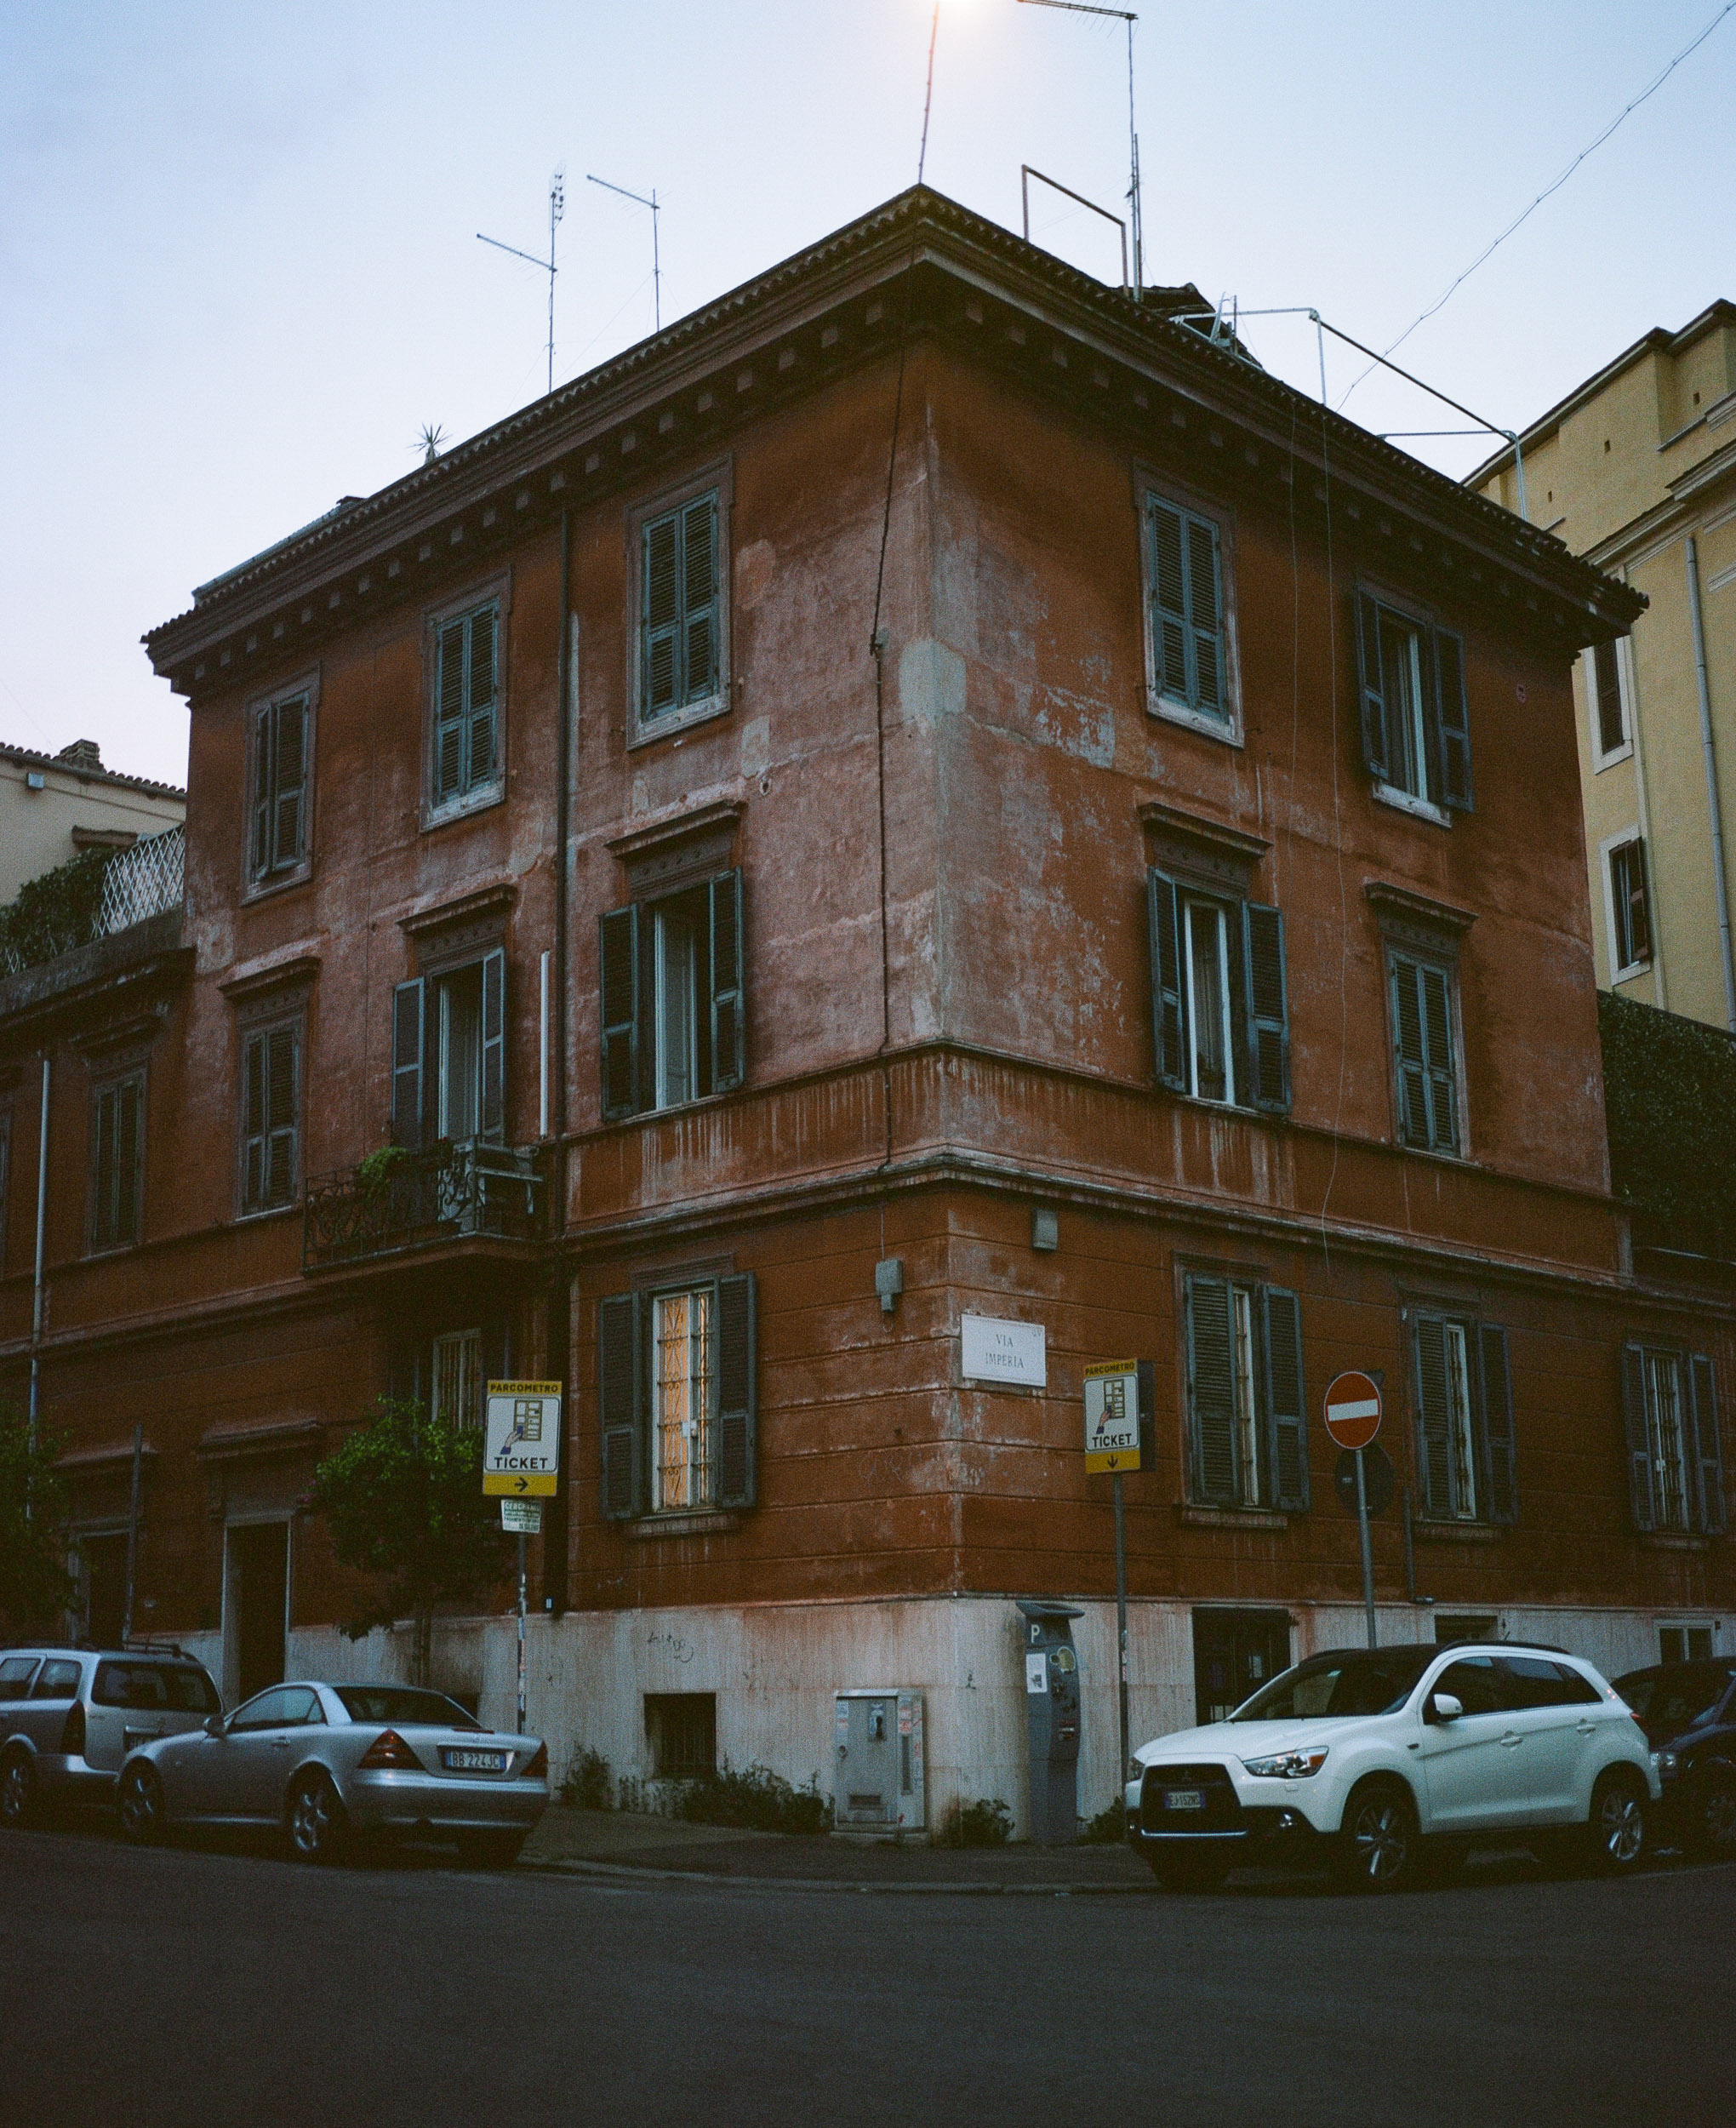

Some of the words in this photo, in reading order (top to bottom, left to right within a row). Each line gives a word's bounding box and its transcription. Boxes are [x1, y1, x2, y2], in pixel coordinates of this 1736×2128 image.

[996, 1334, 1014, 1347] VIA
[985, 1353, 1025, 1369] IMPERIA
[1086, 1361, 1135, 1376] PARCOMETRO
[490, 1382, 558, 1393] PARCOMETRO
[1092, 1433, 1132, 1448] TICKET
[494, 1456, 548, 1469] TICKET
[1031, 1624, 1040, 1644] P
[453, 1752, 465, 1766] BB
